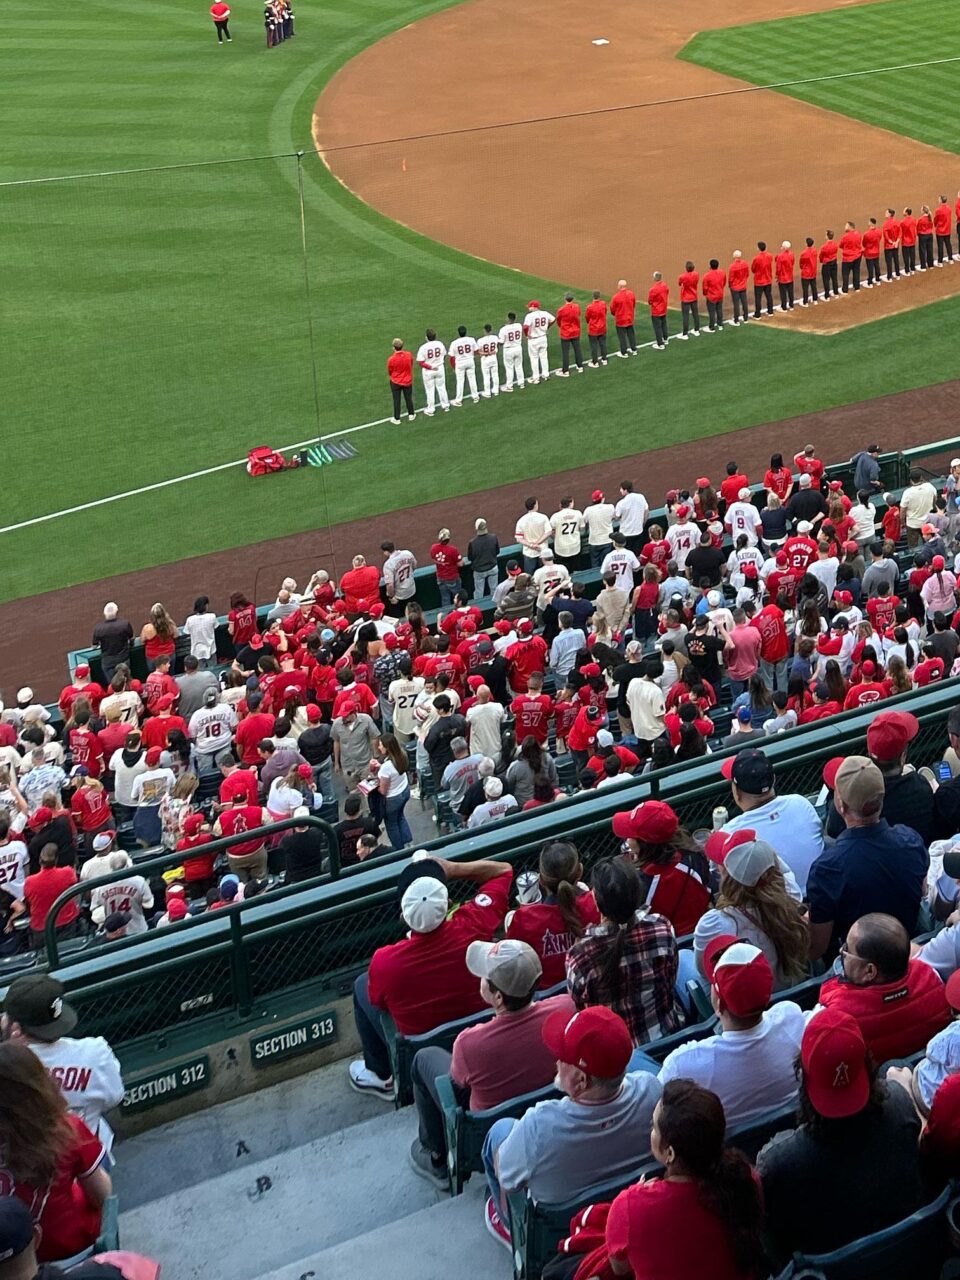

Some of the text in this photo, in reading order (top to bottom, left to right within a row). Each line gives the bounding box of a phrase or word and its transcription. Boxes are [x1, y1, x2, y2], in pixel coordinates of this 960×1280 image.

[561, 522, 577, 535] 27
[737, 517, 745, 529] 9
[676, 538, 691, 550] 14
[610, 563, 627, 575] 27
[792, 555, 809, 567] 27
[397, 566, 411, 582] 27
[762, 622, 781, 639] 27
[397, 693, 417, 709] 27
[521, 711, 543, 727] 27
[204, 722, 222, 738] 18
[71, 747, 90, 762] 27
[109, 898, 132, 914] 14
[255, 1018, 335, 1060] SECTION 313
[122, 1063, 206, 1108] SECTION 312
[235, 1140, 250, 1158] A
